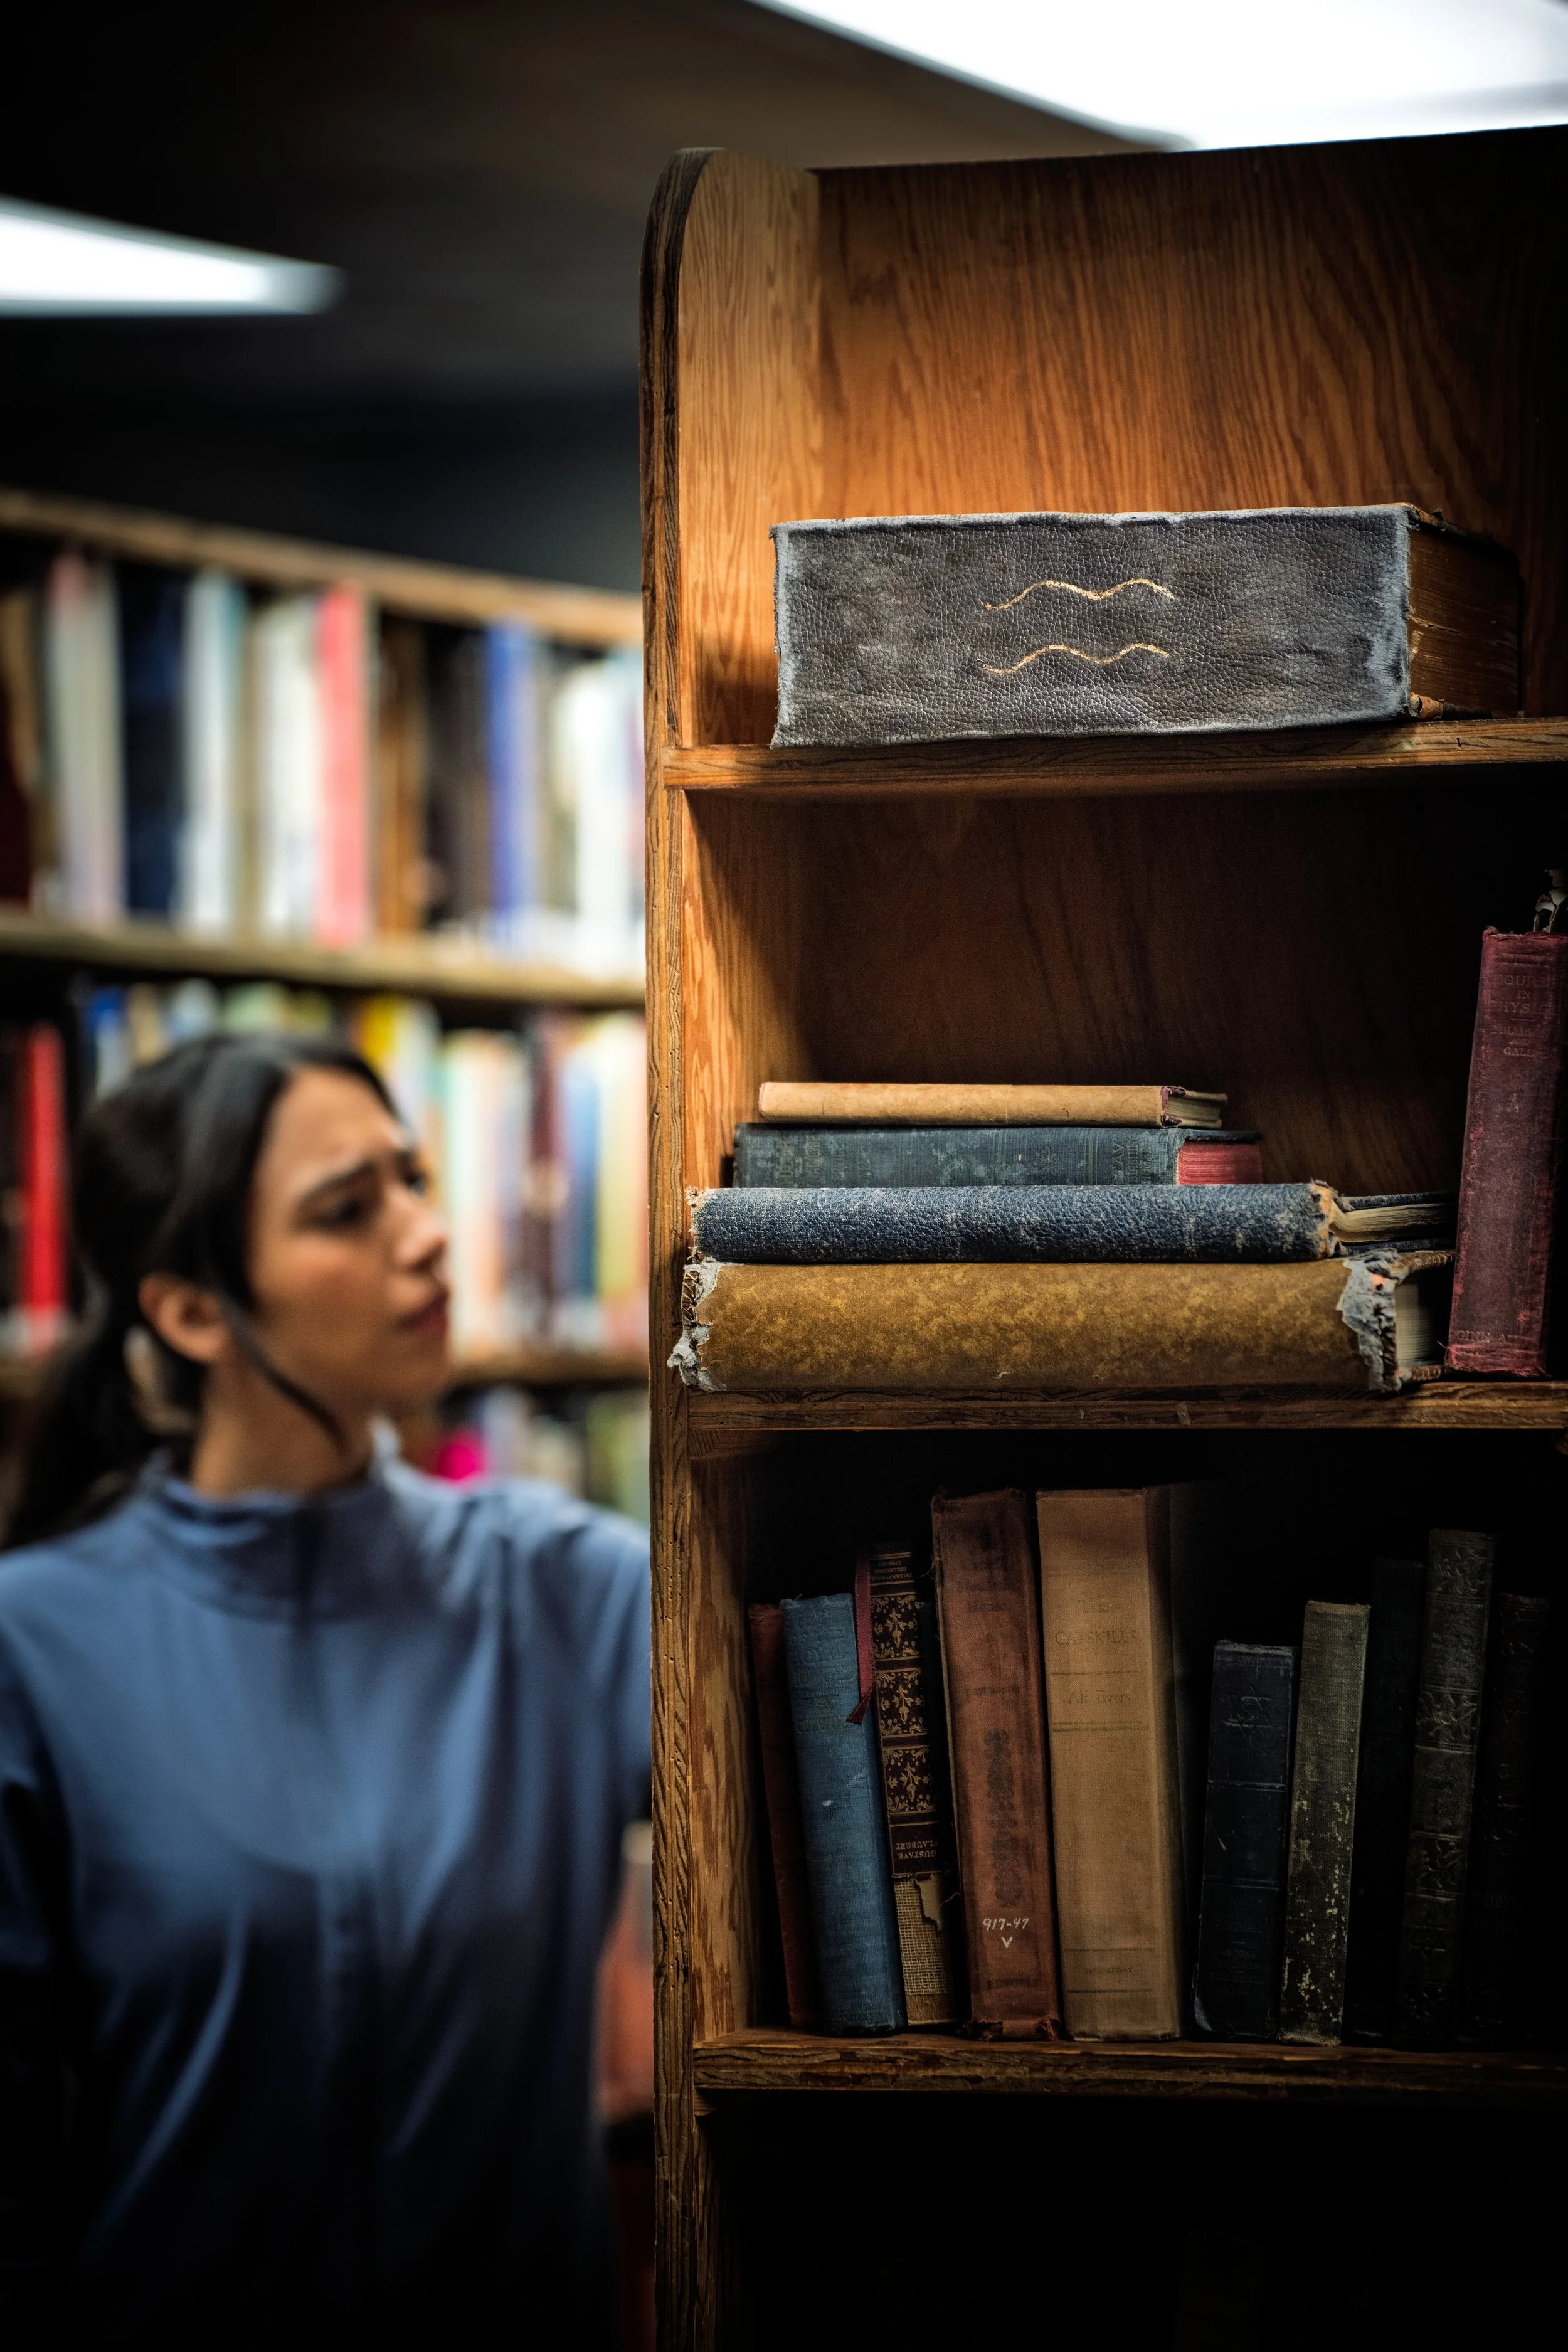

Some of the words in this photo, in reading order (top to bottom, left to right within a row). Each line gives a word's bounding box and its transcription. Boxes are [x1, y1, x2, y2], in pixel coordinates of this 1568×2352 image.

[1517, 990, 1531, 999] IN
[1127, 1134, 1138, 1184] BLISHING
[870, 1572, 913, 1581] INTERNATIONAL
[1054, 1629, 1140, 1645] CATSKILLS
[796, 1717, 857, 1734] CURWO
[895, 1840, 938, 1850] FLAUBERT
[898, 1850, 937, 1860] GUSTAVE
[982, 1917, 1030, 1931] 917-47
[1001, 1936, 1013, 1949] V
